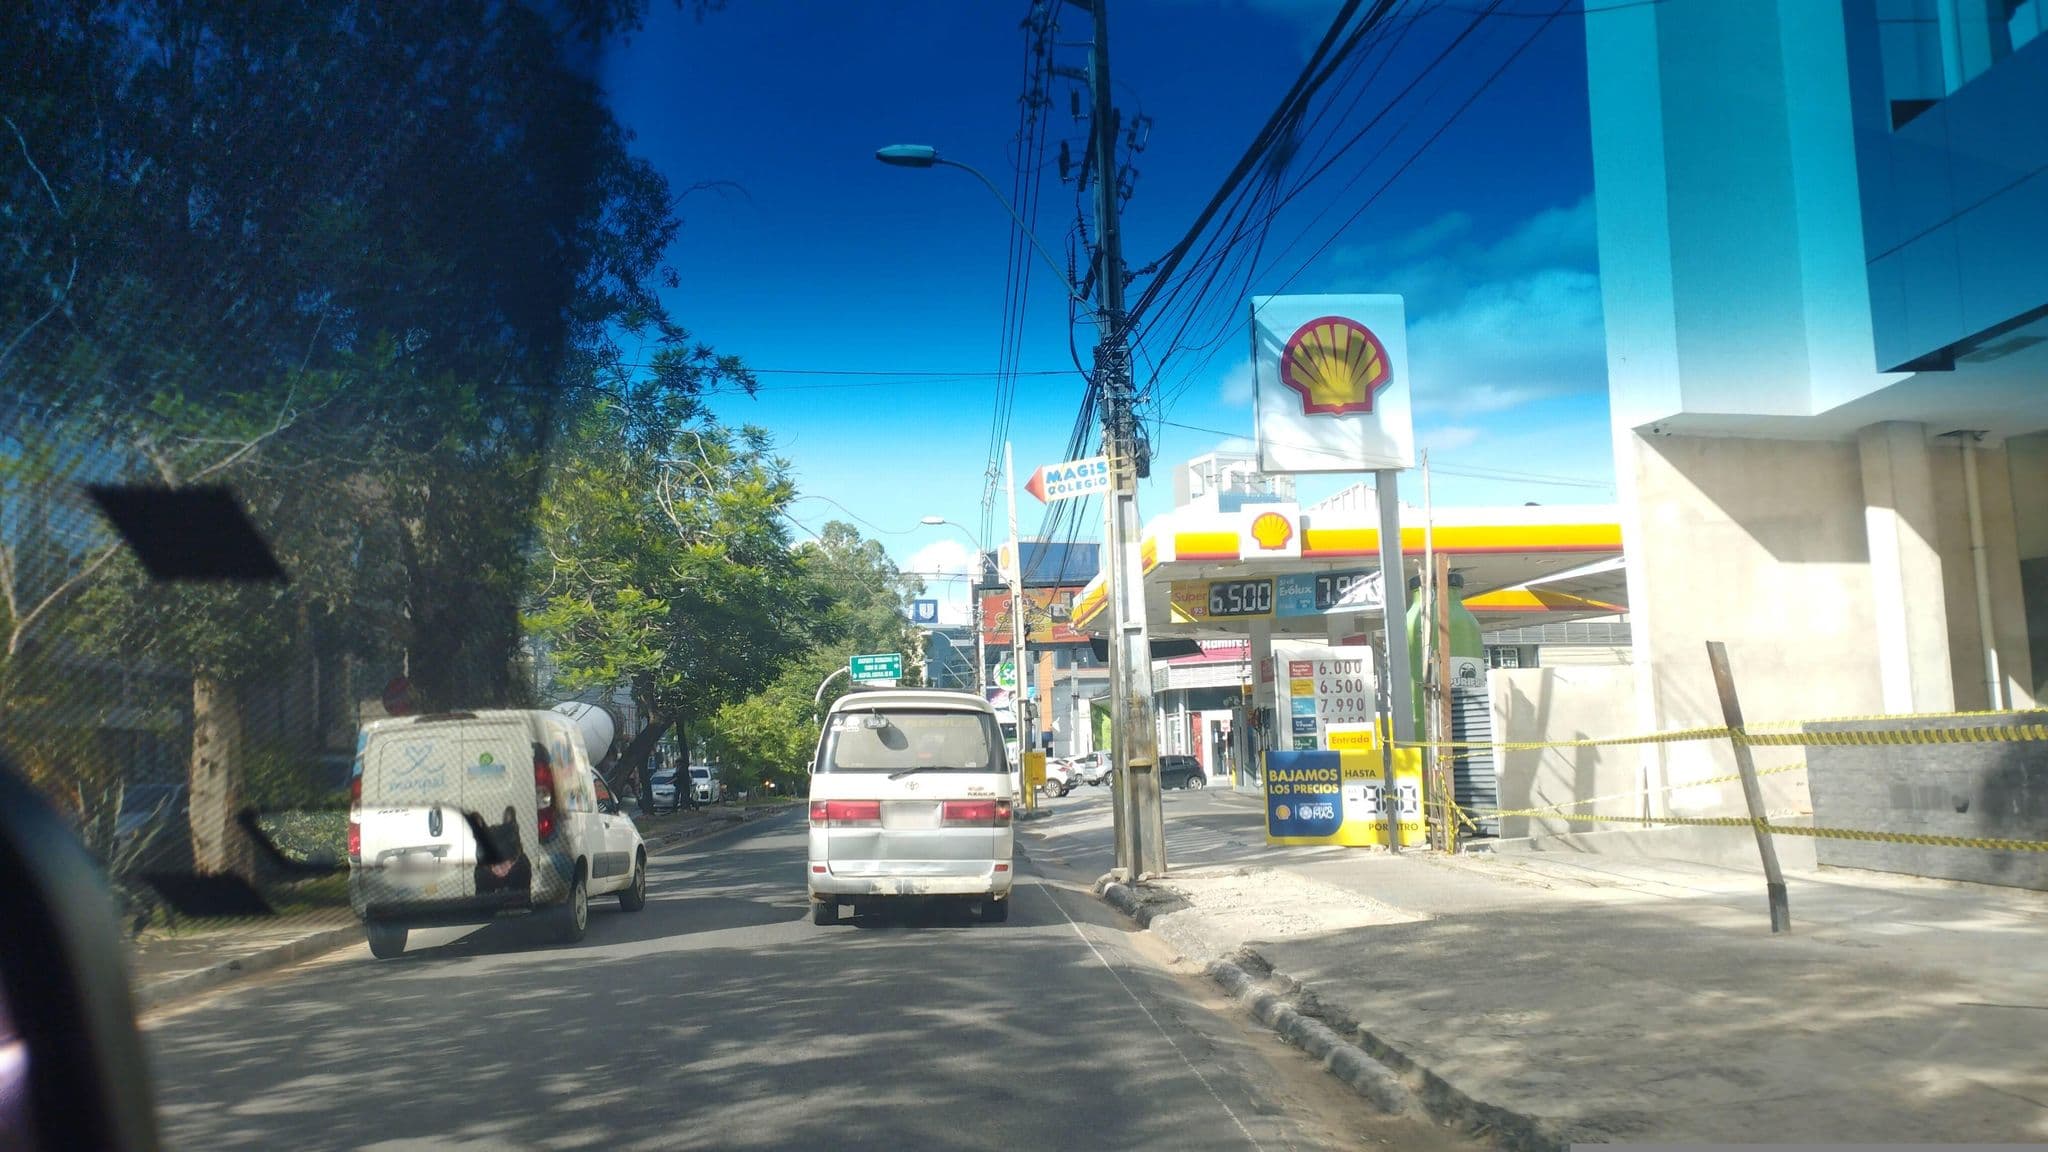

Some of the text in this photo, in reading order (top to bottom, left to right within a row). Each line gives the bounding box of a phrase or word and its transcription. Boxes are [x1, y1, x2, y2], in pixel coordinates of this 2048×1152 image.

[1209, 582, 1271, 614] 6.500
[1319, 661, 1361, 675] 6.000
[1320, 679, 1363, 694] 6.500
[1321, 698, 1364, 713] 7.990
[1331, 735, 1370, 745] Entrada
[1269, 769, 1338, 782] BAJAMOS
[1345, 770, 1377, 778] HASTA
[1269, 783, 1339, 795] LOS PRECIOS
[1368, 822, 1419, 832] POR ITRO
